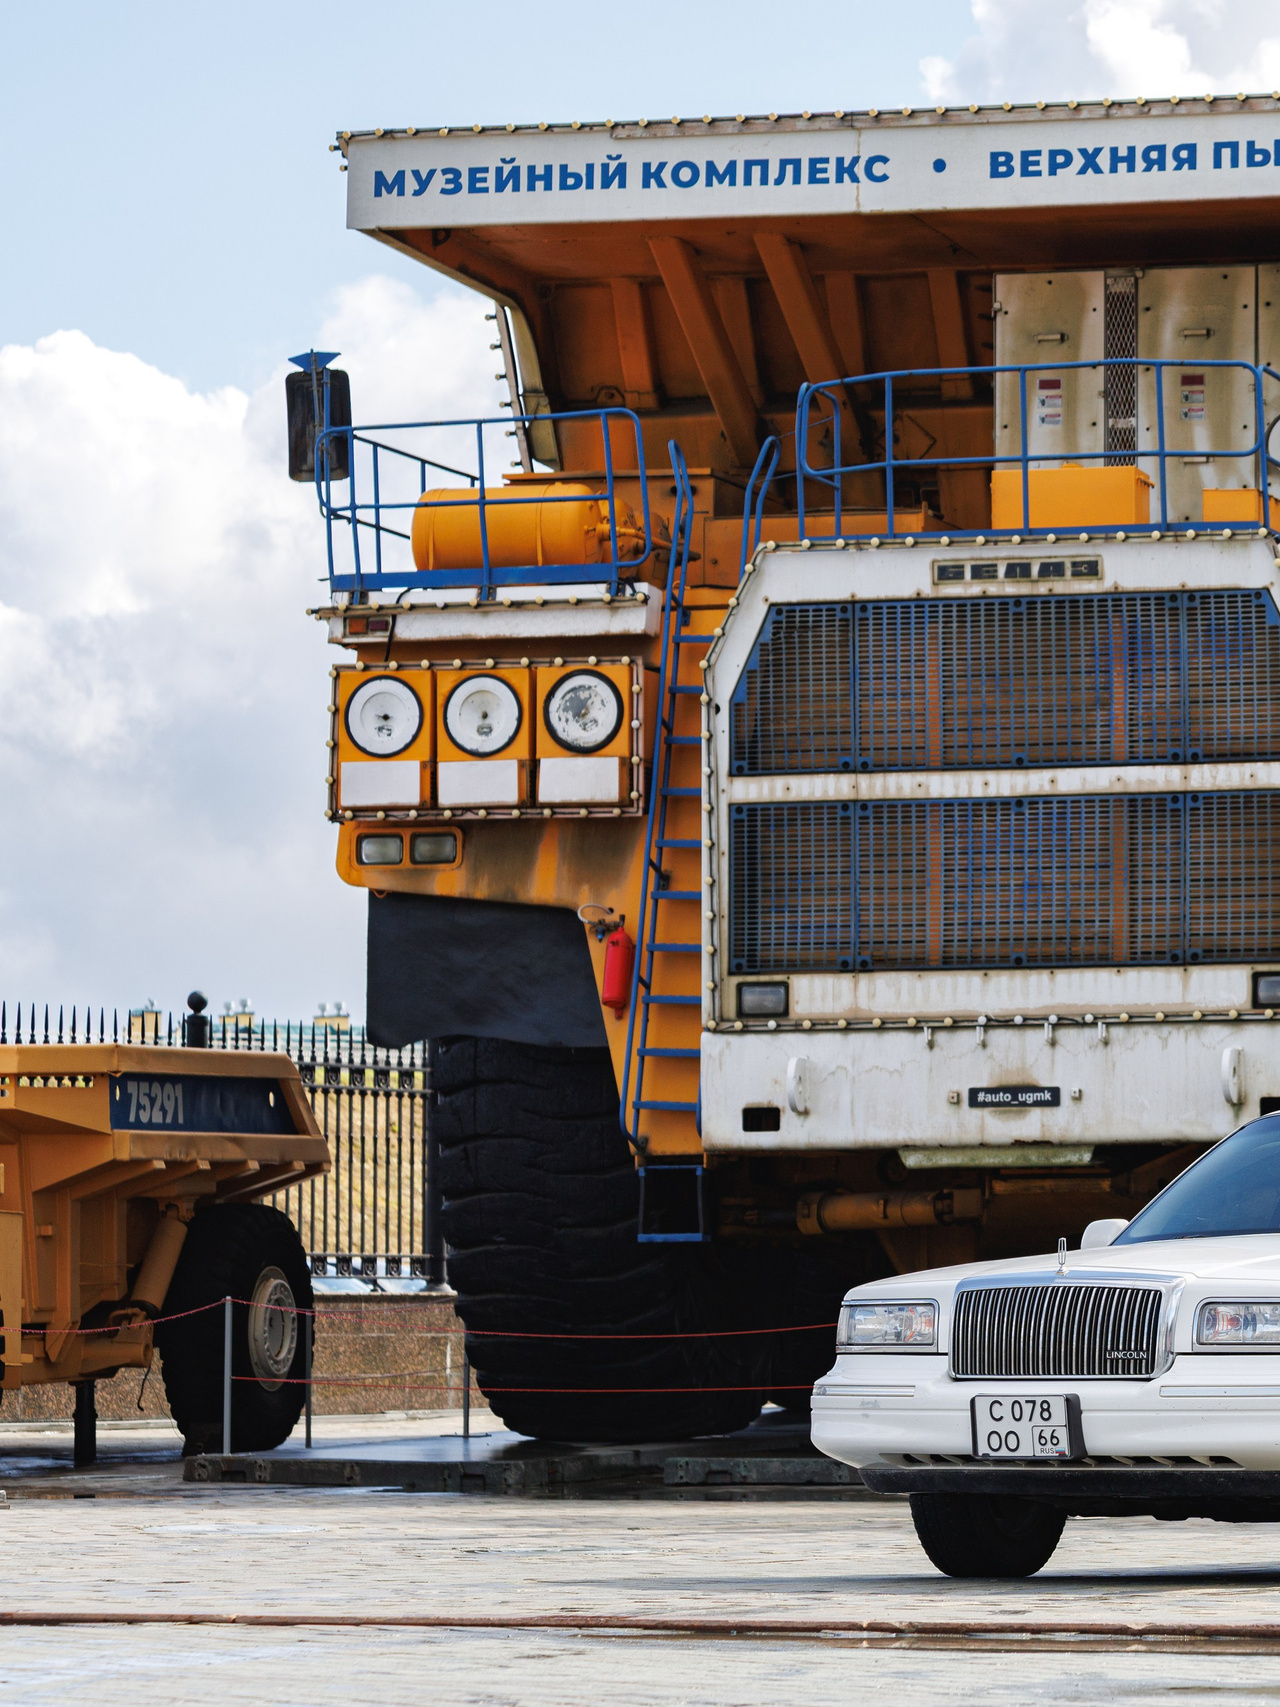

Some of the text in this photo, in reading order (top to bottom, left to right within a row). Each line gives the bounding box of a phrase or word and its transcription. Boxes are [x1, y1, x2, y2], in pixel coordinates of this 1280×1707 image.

[989, 142, 1197, 179] ВЕРХНЯЯ
[373, 153, 890, 197] МУЗЕЙНЫЙ КОМПЛЕКС
[127, 1081, 184, 1124] 75291
[977, 1089, 1052, 1104] #auto_ugmk
[1106, 1351, 1147, 1359] LINCOLN
[1038, 1429, 1060, 1446] 66
